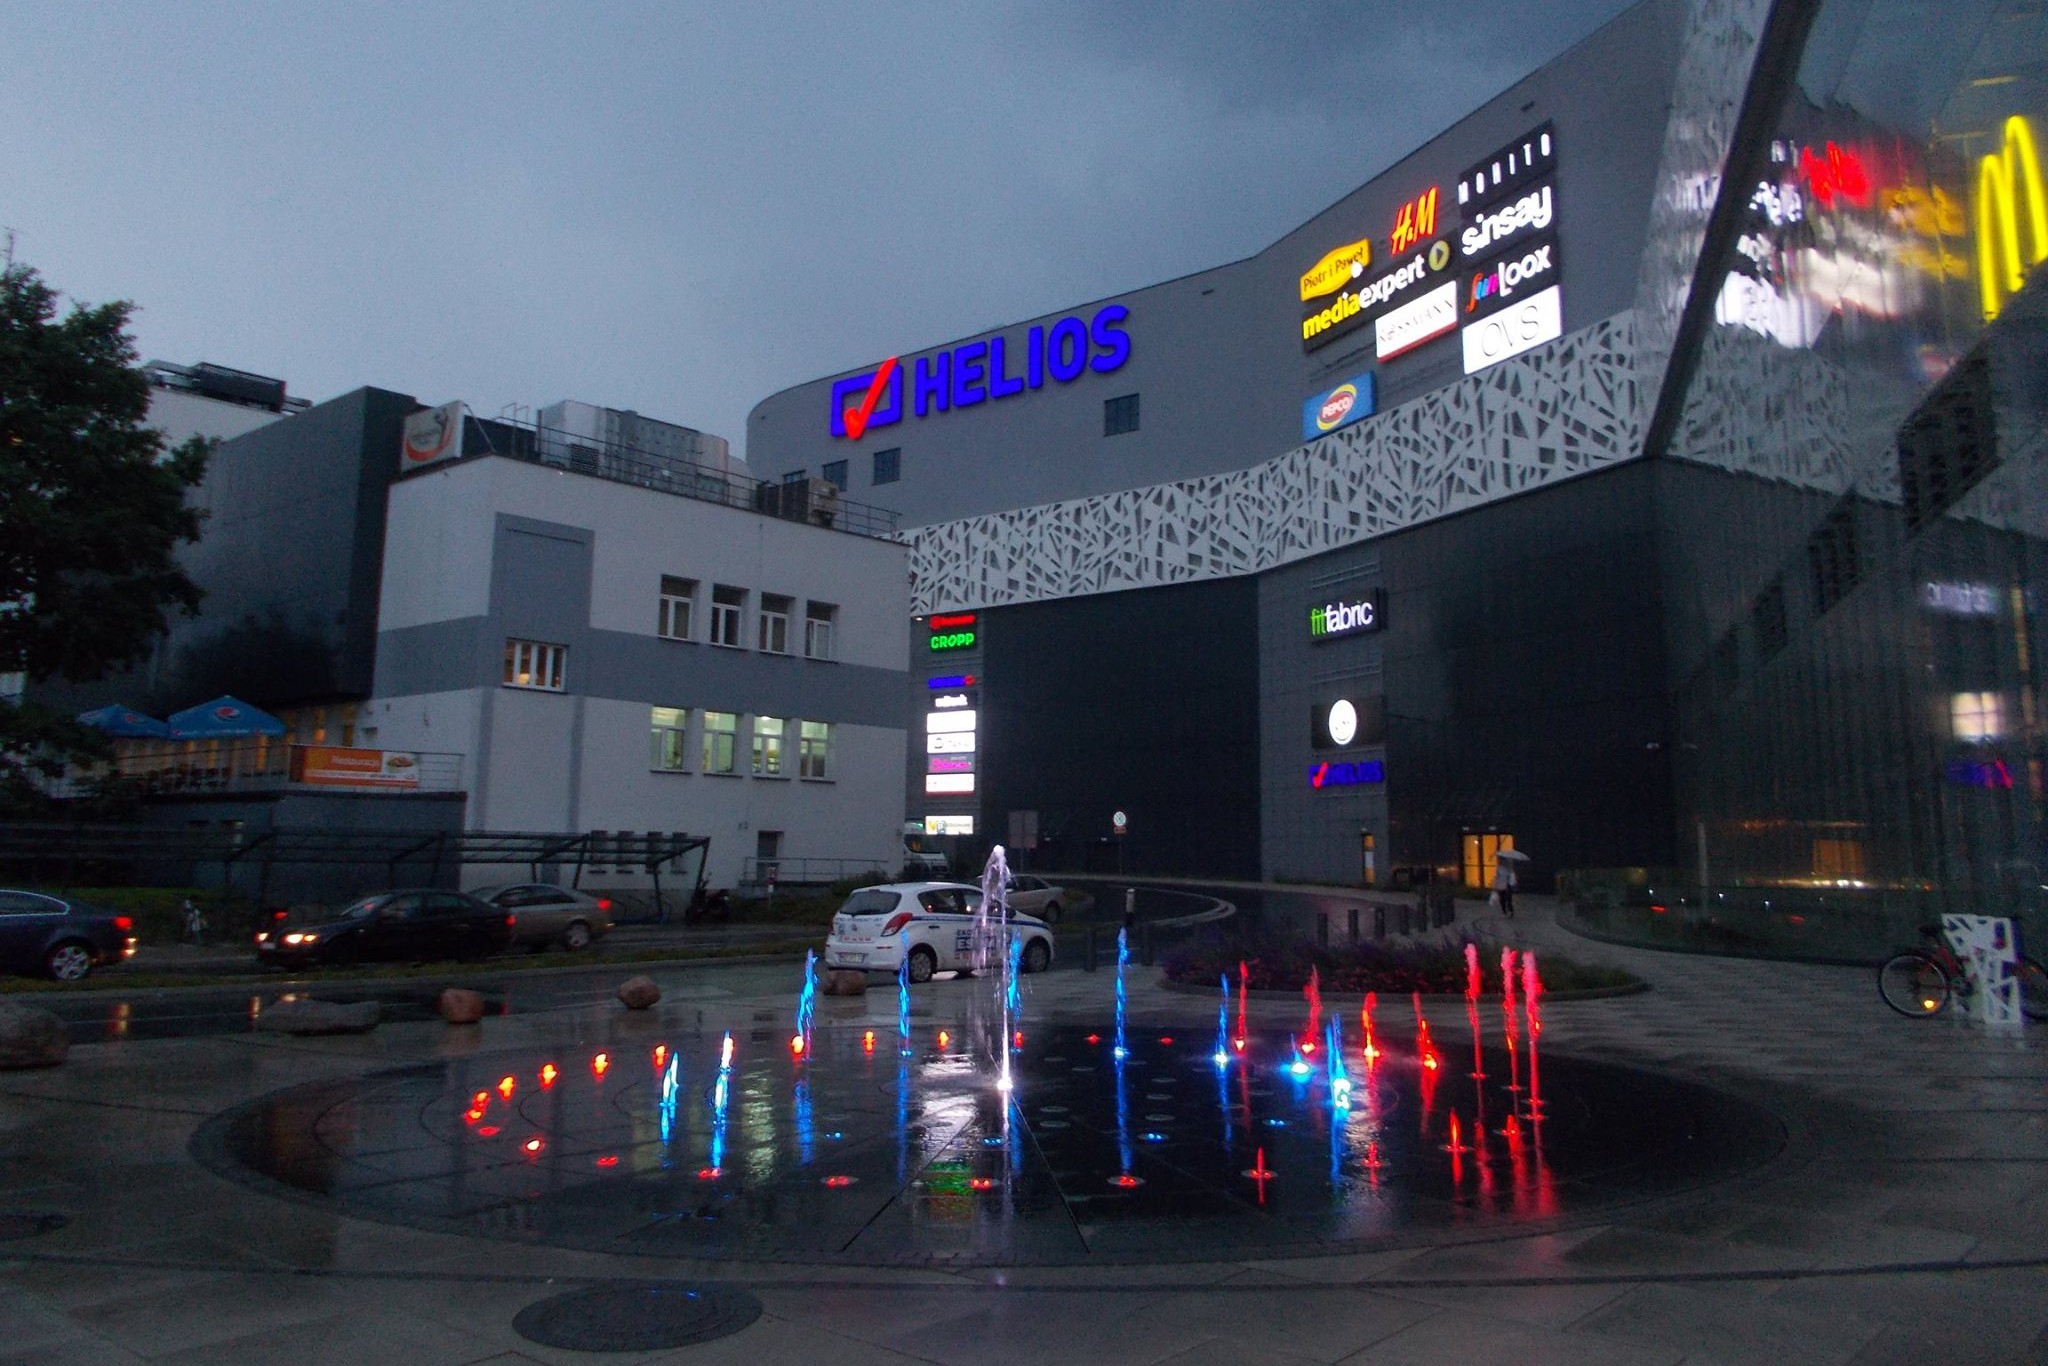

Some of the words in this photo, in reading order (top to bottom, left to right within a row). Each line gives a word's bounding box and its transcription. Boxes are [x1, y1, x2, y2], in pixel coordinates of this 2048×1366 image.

[1390, 186, 1438, 255] H&M
[1462, 186, 1552, 255] sinsay
[1303, 253, 1426, 340] mediaexpert
[914, 304, 1131, 418] HELIOS
